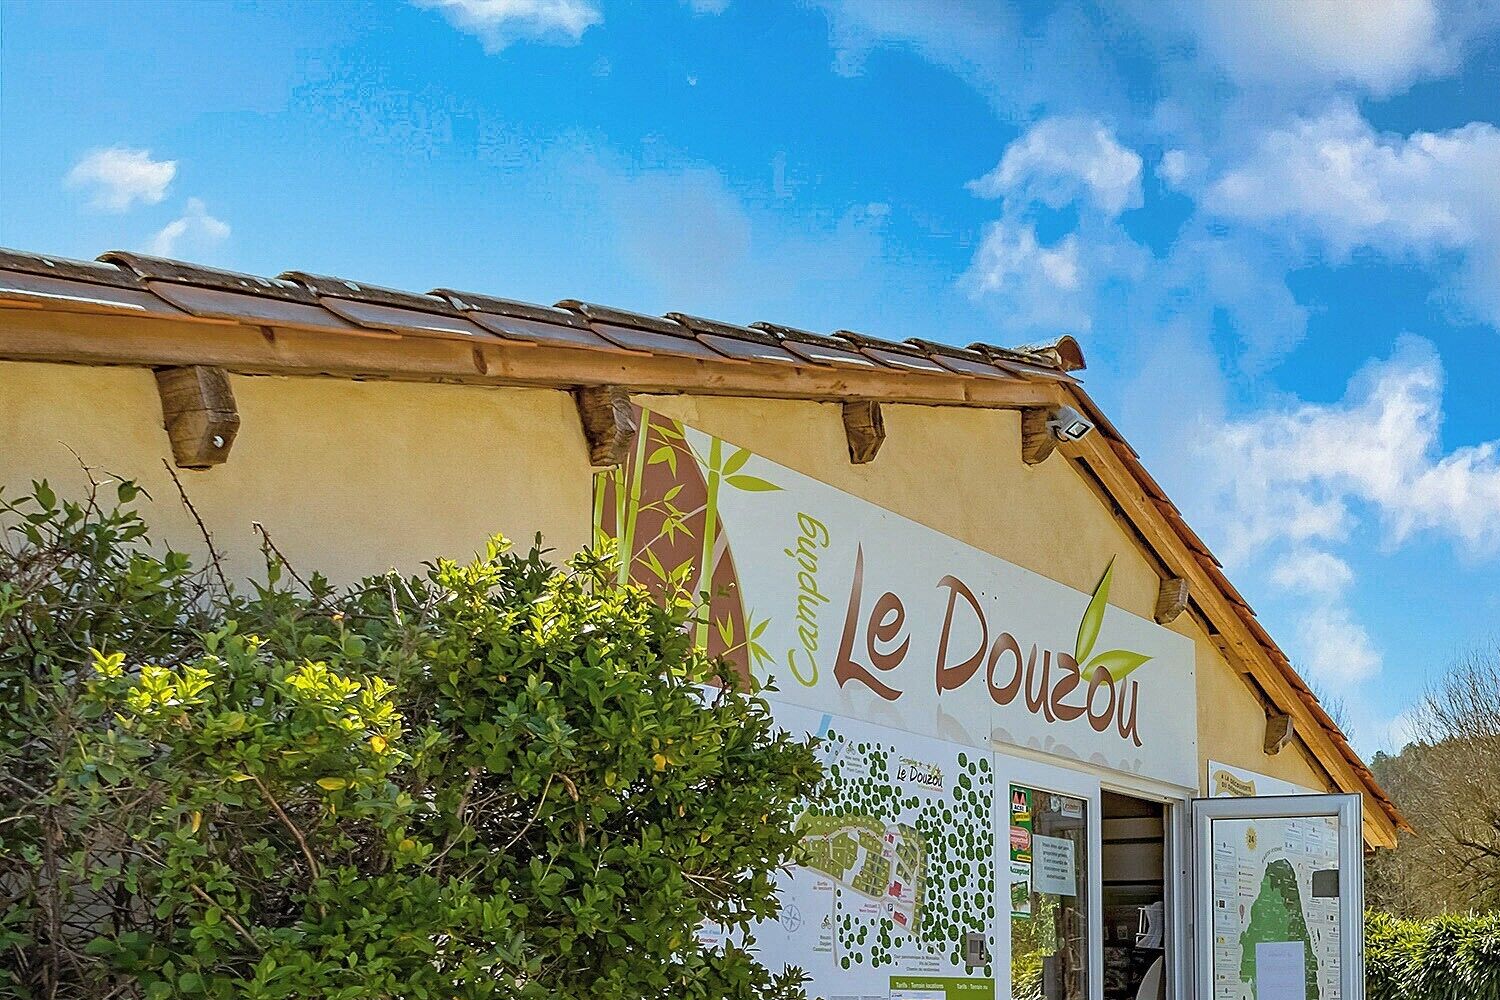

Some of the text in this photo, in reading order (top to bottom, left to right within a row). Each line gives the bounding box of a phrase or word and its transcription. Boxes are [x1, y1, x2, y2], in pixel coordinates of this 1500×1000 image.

[785, 511, 831, 688] Camping
[832, 541, 1143, 748] Le Douzou
[897, 765, 943, 788] Le Douzou
